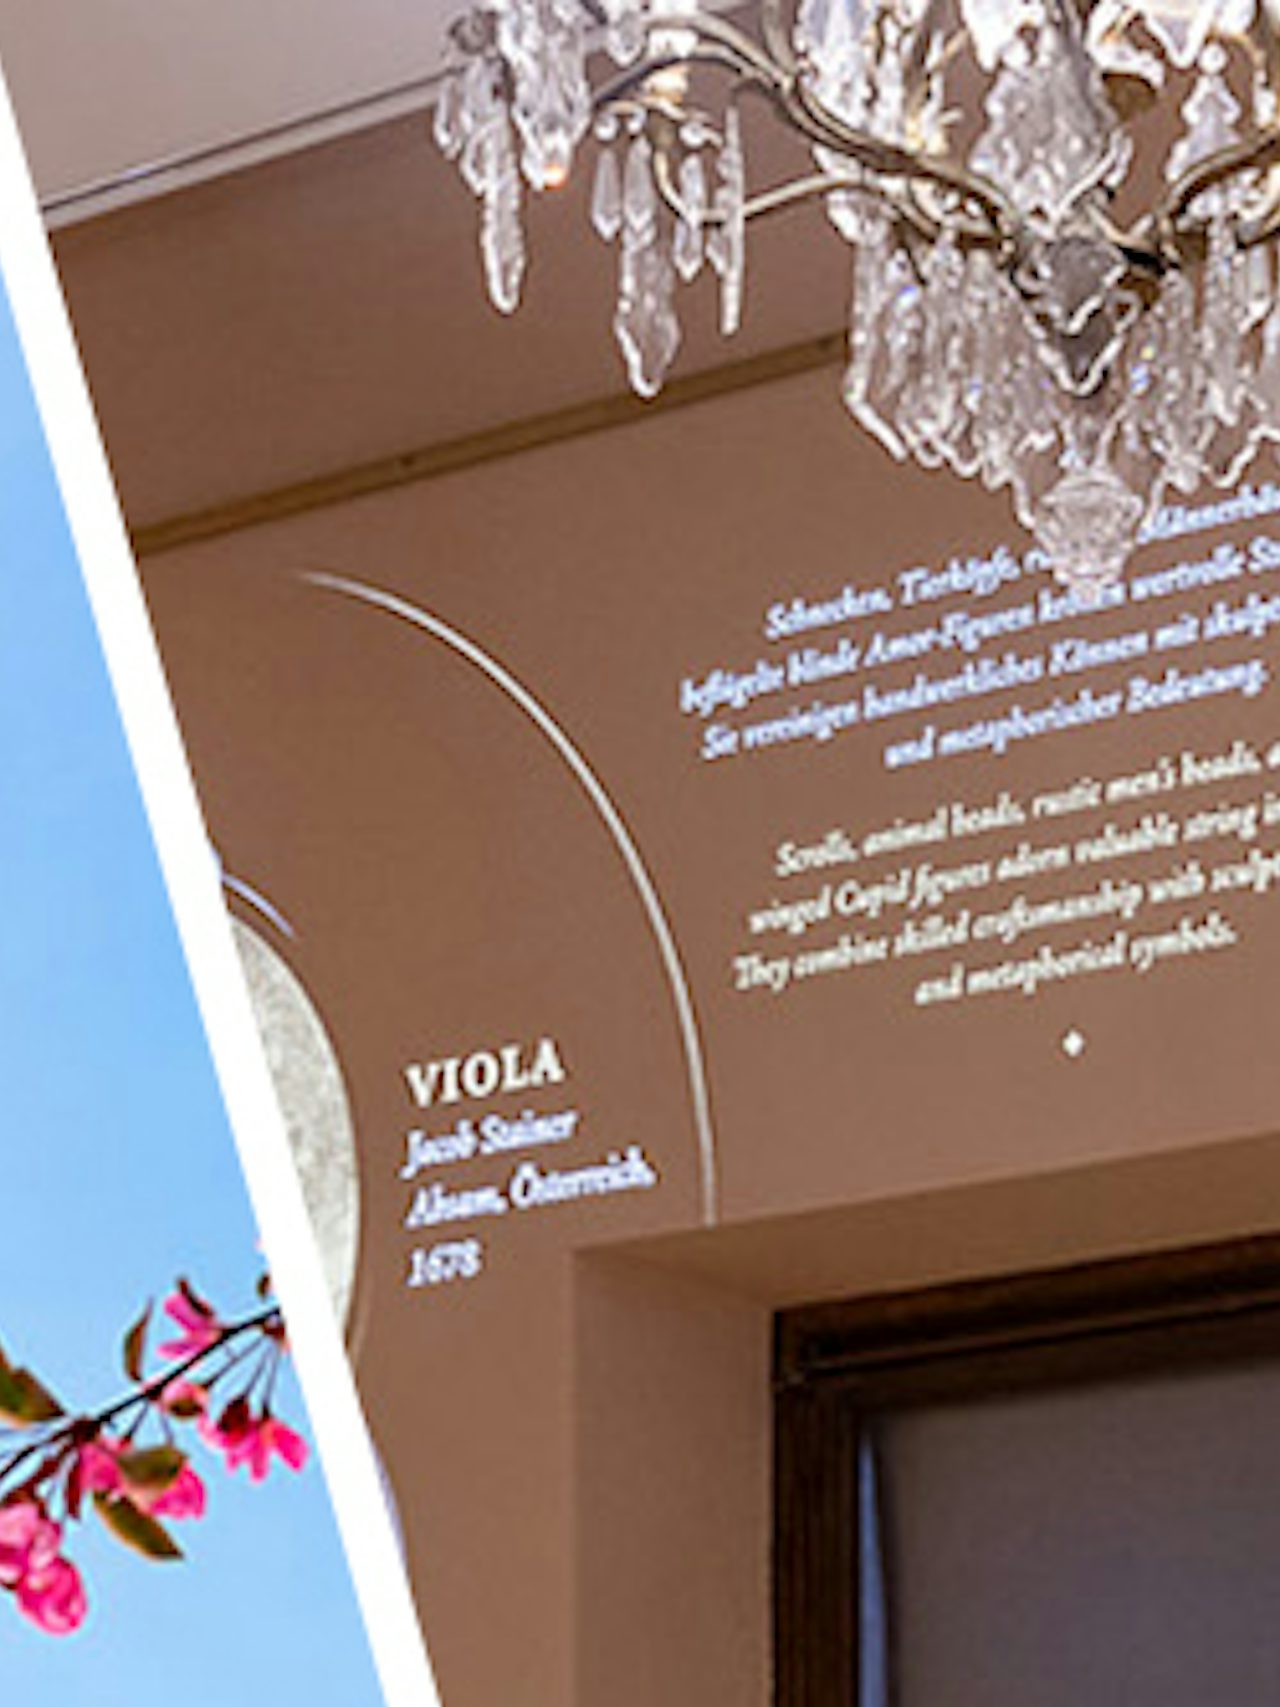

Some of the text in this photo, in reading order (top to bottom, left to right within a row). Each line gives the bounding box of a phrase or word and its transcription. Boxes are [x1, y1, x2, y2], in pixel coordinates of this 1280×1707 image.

[702, 722, 739, 759] Sie
[1154, 613, 1199, 650] mit
[788, 639, 861, 685] blinde
[885, 725, 936, 767] und
[863, 807, 947, 856] animal
[1033, 778, 1101, 817] rustic
[750, 885, 831, 934] winged
[835, 869, 910, 917] Cupid
[908, 863, 991, 910] figures
[996, 843, 1069, 880] adorn
[1075, 813, 1178, 863] valuable
[1183, 804, 1257, 840] string
[734, 955, 791, 992] They
[792, 934, 888, 977] combine
[894, 909, 970, 956] skilled
[973, 880, 1142, 942] craftsmanship
[1148, 861, 1205, 902] with
[915, 964, 963, 1004] and
[967, 931, 1126, 993] metaphorical
[407, 1039, 563, 1107] VIOLA
[407, 1239, 480, 1287] 1678
